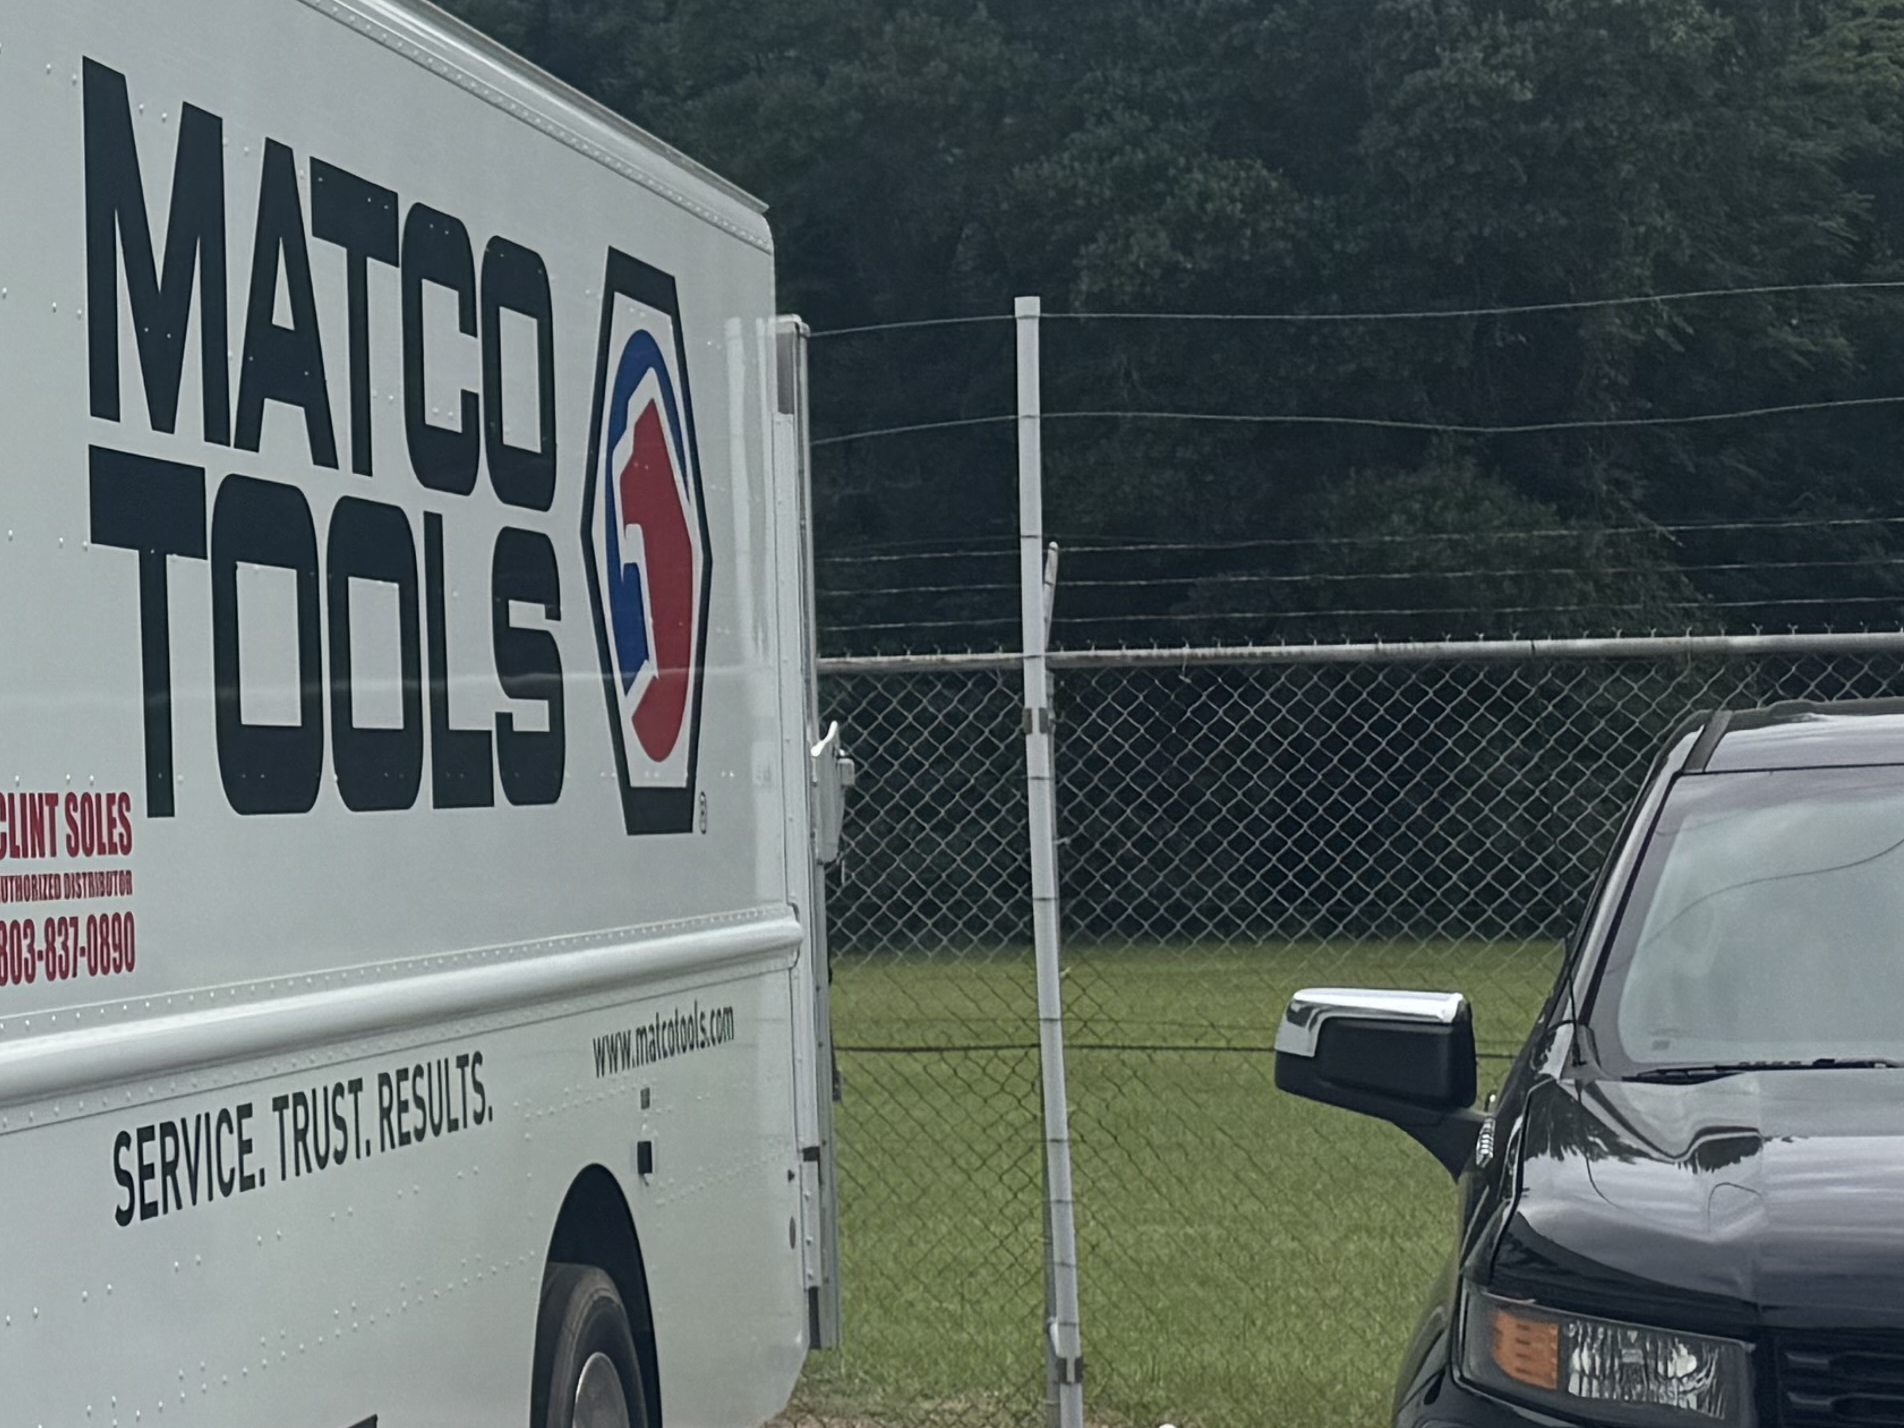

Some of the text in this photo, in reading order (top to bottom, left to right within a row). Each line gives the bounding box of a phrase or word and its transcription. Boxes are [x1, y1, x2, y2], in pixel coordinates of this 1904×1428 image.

[82, 56, 558, 512] MATCO
[88, 444, 566, 819] TOOLS
[64, 791, 132, 857] SOLES
[64, 869, 133, 900] DISTRIBUTOR
[592, 999, 735, 1079] www.matcotools.com
[113, 1050, 493, 1228] SERVICE. TRUST. RESULTS.
